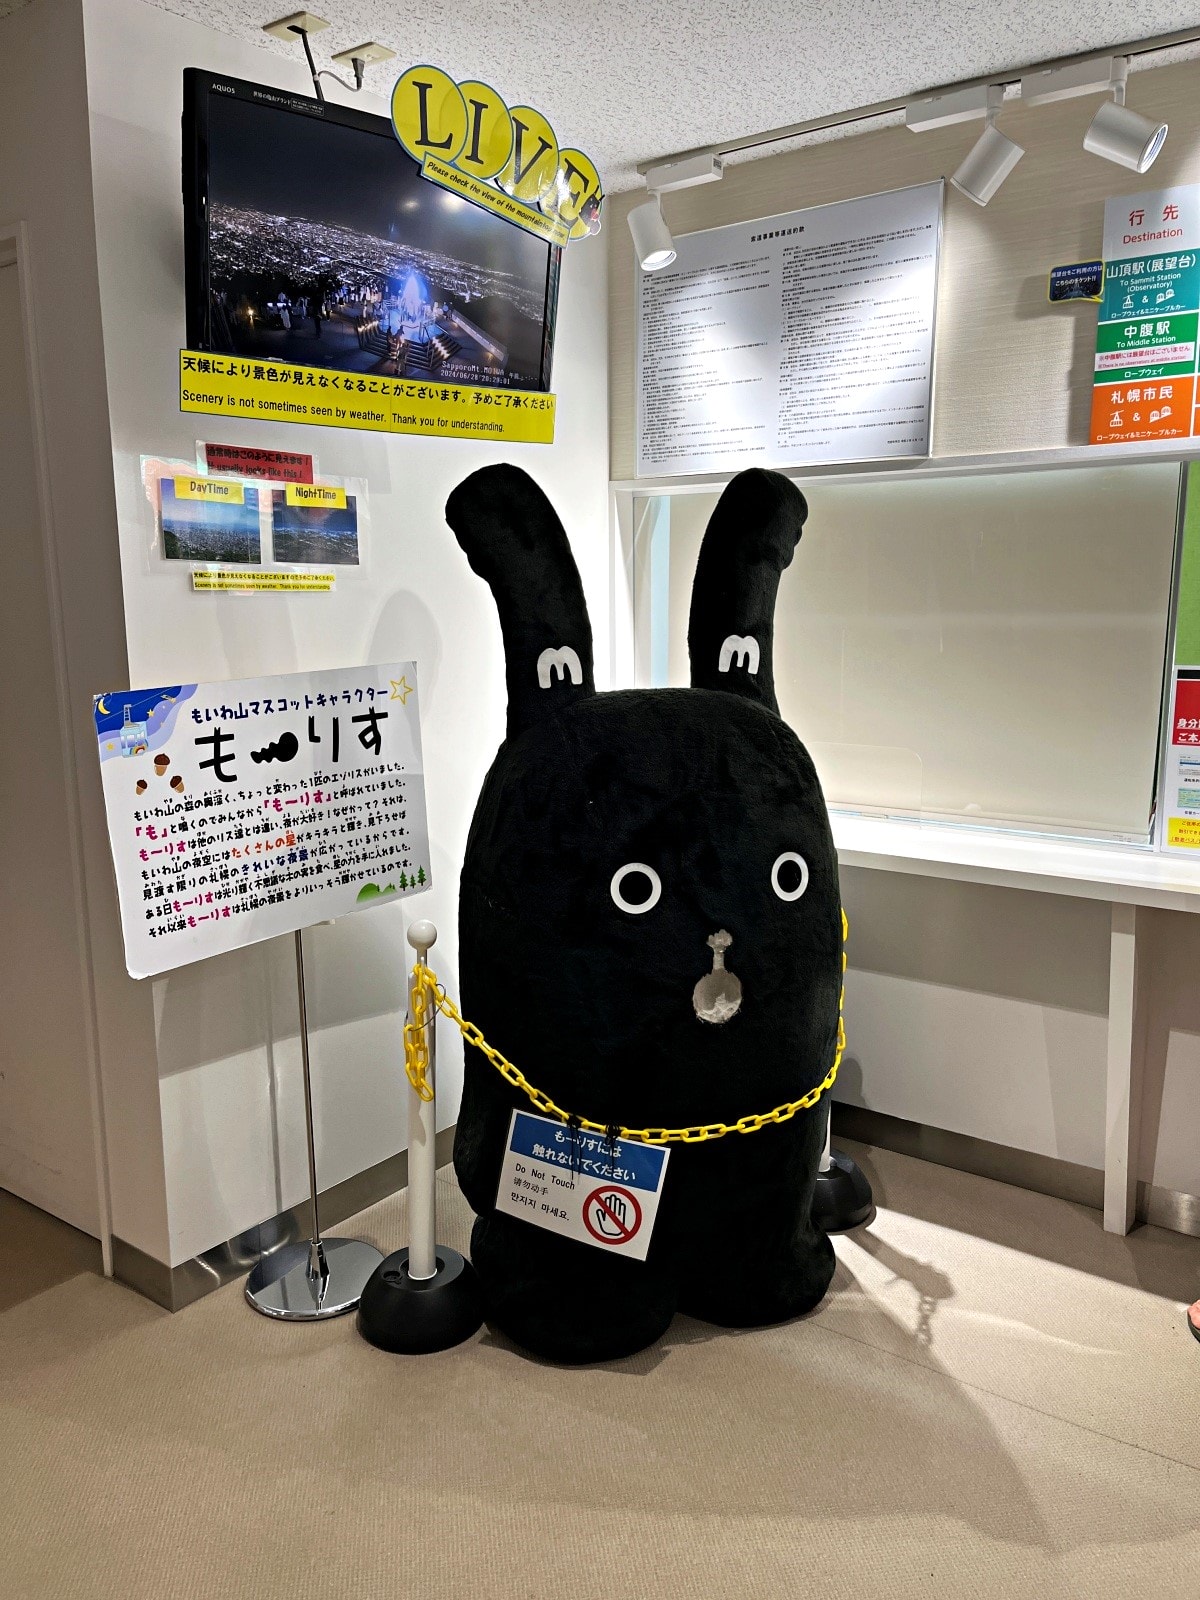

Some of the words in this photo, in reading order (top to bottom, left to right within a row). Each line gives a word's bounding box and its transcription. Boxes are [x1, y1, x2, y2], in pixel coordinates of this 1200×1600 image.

[212, 83, 236, 97] AQUOS
[411, 80, 589, 228] LIVE
[427, 161, 449, 177] Please
[449, 172, 468, 189] check
[470, 184, 481, 195] the
[482, 188, 496, 202] view
[497, 197, 506, 206] of
[506, 201, 516, 213] the
[1123, 228, 1183, 245] Destination
[1157, 272, 1182, 281] Station
[1127, 281, 1173, 293] (Observatory)
[1124, 320, 1170, 339] 中腹駅
[1127, 339, 1150, 348] Middle
[1152, 336, 1176, 345] Station
[440, 370, 478, 381] 2024/06/28
[1124, 367, 1164, 378] ロープウェイ
[1110, 385, 1173, 405] 札幌市民
[183, 389, 224, 406] Scenery
[227, 395, 235, 406] is
[239, 397, 254, 408] not
[258, 398, 307, 414] sometimes
[311, 407, 332, 417] seen
[336, 407, 346, 419] by
[350, 410, 386, 423] weather.
[392, 412, 417, 425] Thank
[420, 417, 434, 428] you
[437, 417, 448, 428] for
[451, 419, 505, 433] understanding.
[190, 481, 229, 496] DayTime
[294, 486, 337, 500] NightTime
[192, 688, 388, 723] もいわ山マスコットキャラクター
[555, 1130, 623, 1158] もーりすには
[532, 1143, 636, 1181] 触れないでください
[513, 1176, 549, 1196] 请勿动手
[515, 1163, 526, 1174] Do
[531, 1168, 546, 1181] Not
[551, 1175, 576, 1190] Touch
[510, 1192, 537, 1209] 만지지
[541, 1202, 570, 1221] 마세요.
